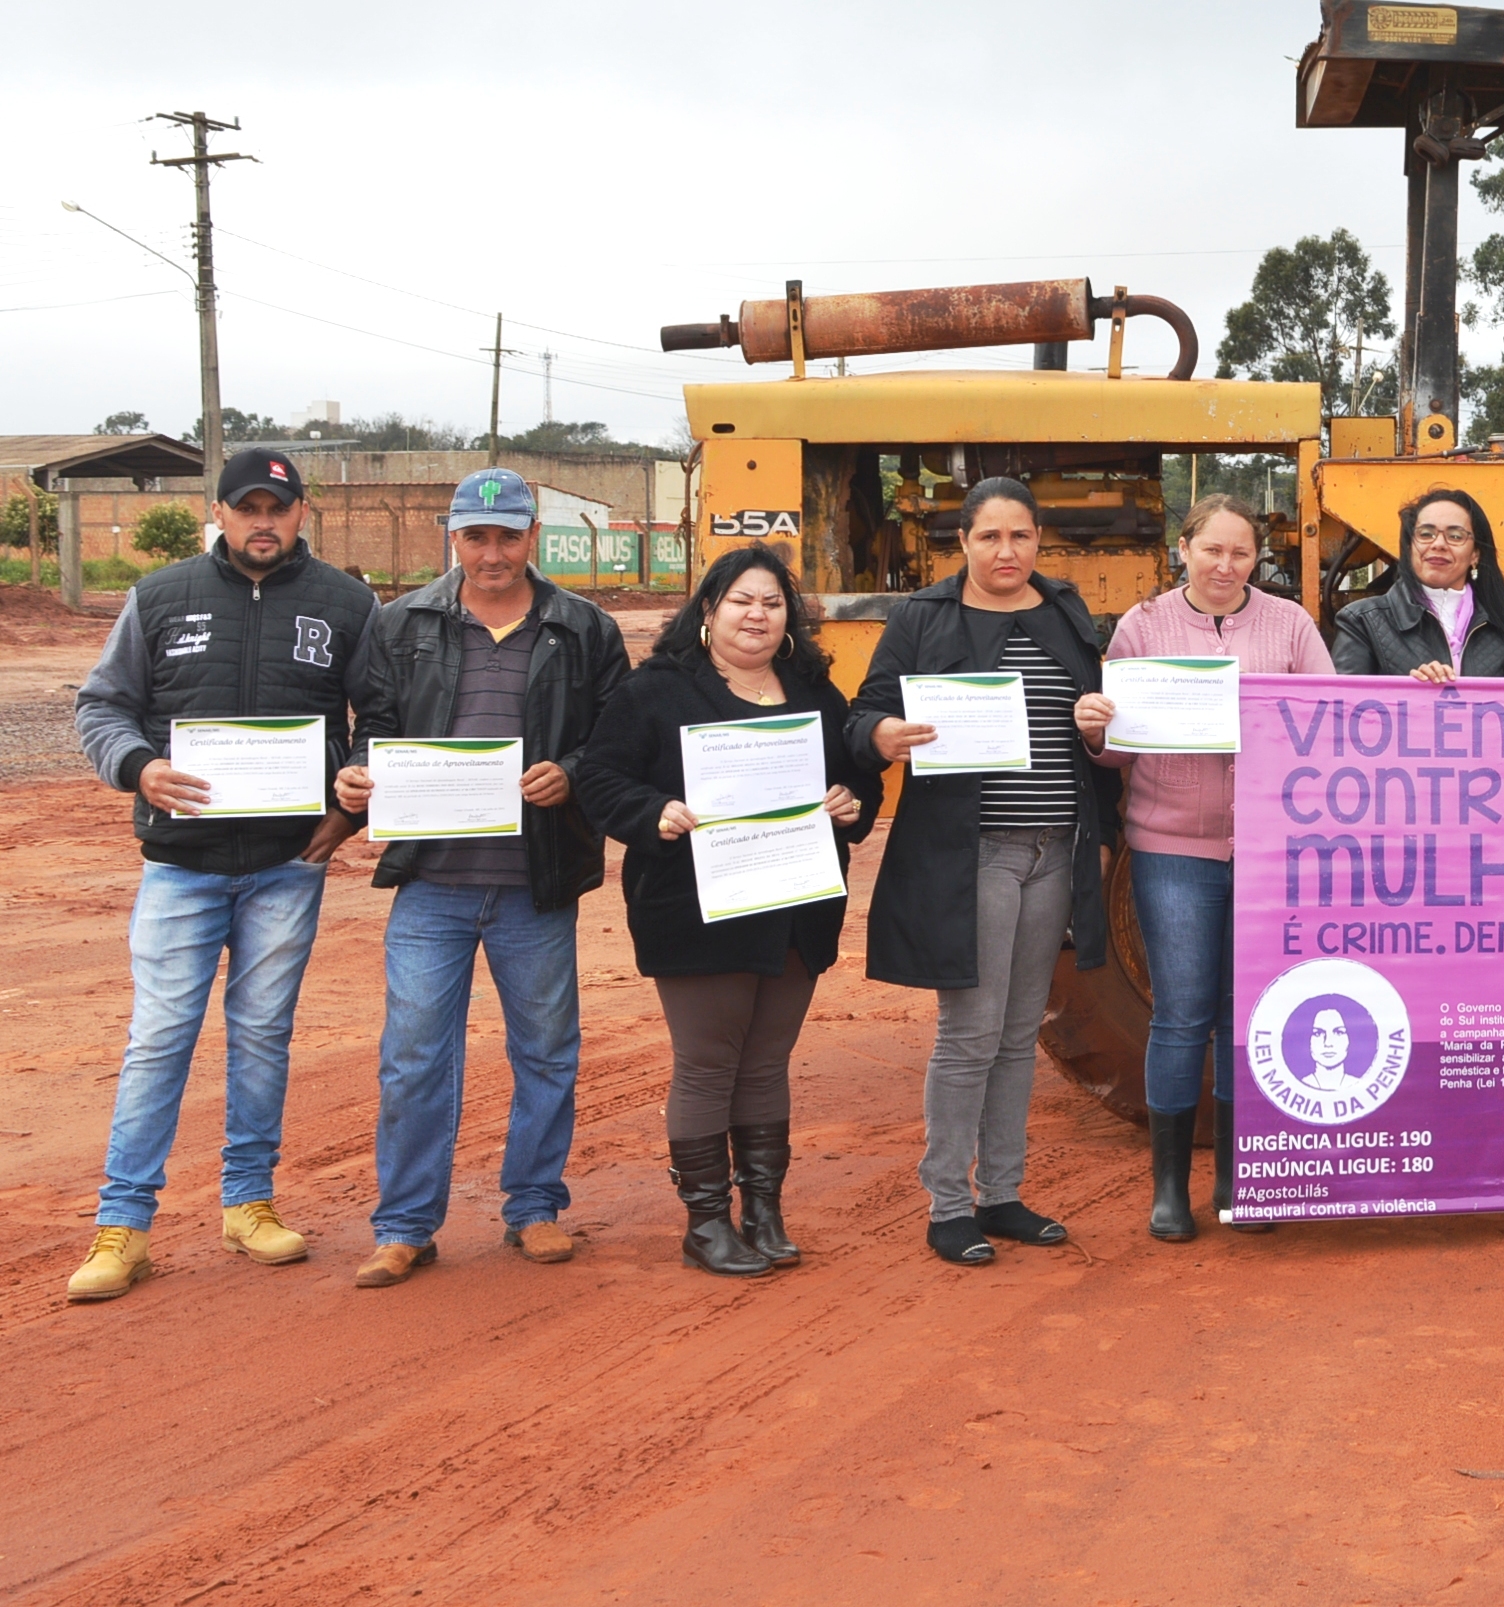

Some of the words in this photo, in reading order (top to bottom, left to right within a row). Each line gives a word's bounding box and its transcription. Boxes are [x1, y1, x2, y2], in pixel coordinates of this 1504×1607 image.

[713, 511, 799, 536] 55A
[546, 535, 632, 563] FASCNIUS
[293, 615, 333, 668] R
[190, 738, 233, 747] Certificado
[235, 737, 244, 746] de
[246, 737, 306, 746] Aproveitamento
[702, 742, 742, 753] Certificado
[744, 741, 752, 749] de
[753, 736, 808, 749] Aproveitamento
[387, 760, 430, 768] Certificado
[443, 759, 504, 768] Aproveitamento
[710, 834, 750, 848] Certificado
[751, 832, 759, 840] de
[760, 822, 816, 839] Aproveitamento
[1283, 915, 1302, 955] É
[1317, 921, 1447, 955] CRIME.
[1440, 1003, 1449, 1013] O
[1457, 1003, 1501, 1012] Governo
[1440, 1016, 1453, 1026] do
[1459, 1015, 1474, 1025] Sul
[1440, 1030, 1446, 1038] a
[1453, 1028, 1504, 1040] campanha
[1255, 1030, 1273, 1065] LEI
[1440, 1041, 1472, 1051] "Maria
[1480, 1040, 1492, 1050] da
[1366, 1028, 1405, 1101] PENHA
[1440, 1053, 1494, 1064] sensibilizar
[1440, 1066, 1490, 1076] doméstica
[1262, 1068, 1323, 1118] MARIA
[1440, 1079, 1472, 1089] Penha
[1477, 1078, 1495, 1089] (Lei
[1333, 1096, 1365, 1118] DA
[1238, 1131, 1331, 1152] URGÊNCIA
[1336, 1132, 1394, 1149] LIGUE:
[1399, 1131, 1432, 1147] 190
[1238, 1157, 1334, 1178] DENÚNCIA
[1339, 1158, 1396, 1175] LIGUE:
[1401, 1156, 1434, 1173] 180
[1237, 1183, 1329, 1202] #AgostoLilás
[1235, 1202, 1306, 1220] #Itaquiraí
[1309, 1203, 1356, 1216] contra
[1360, 1204, 1369, 1214] a
[1372, 1198, 1436, 1213] violência
